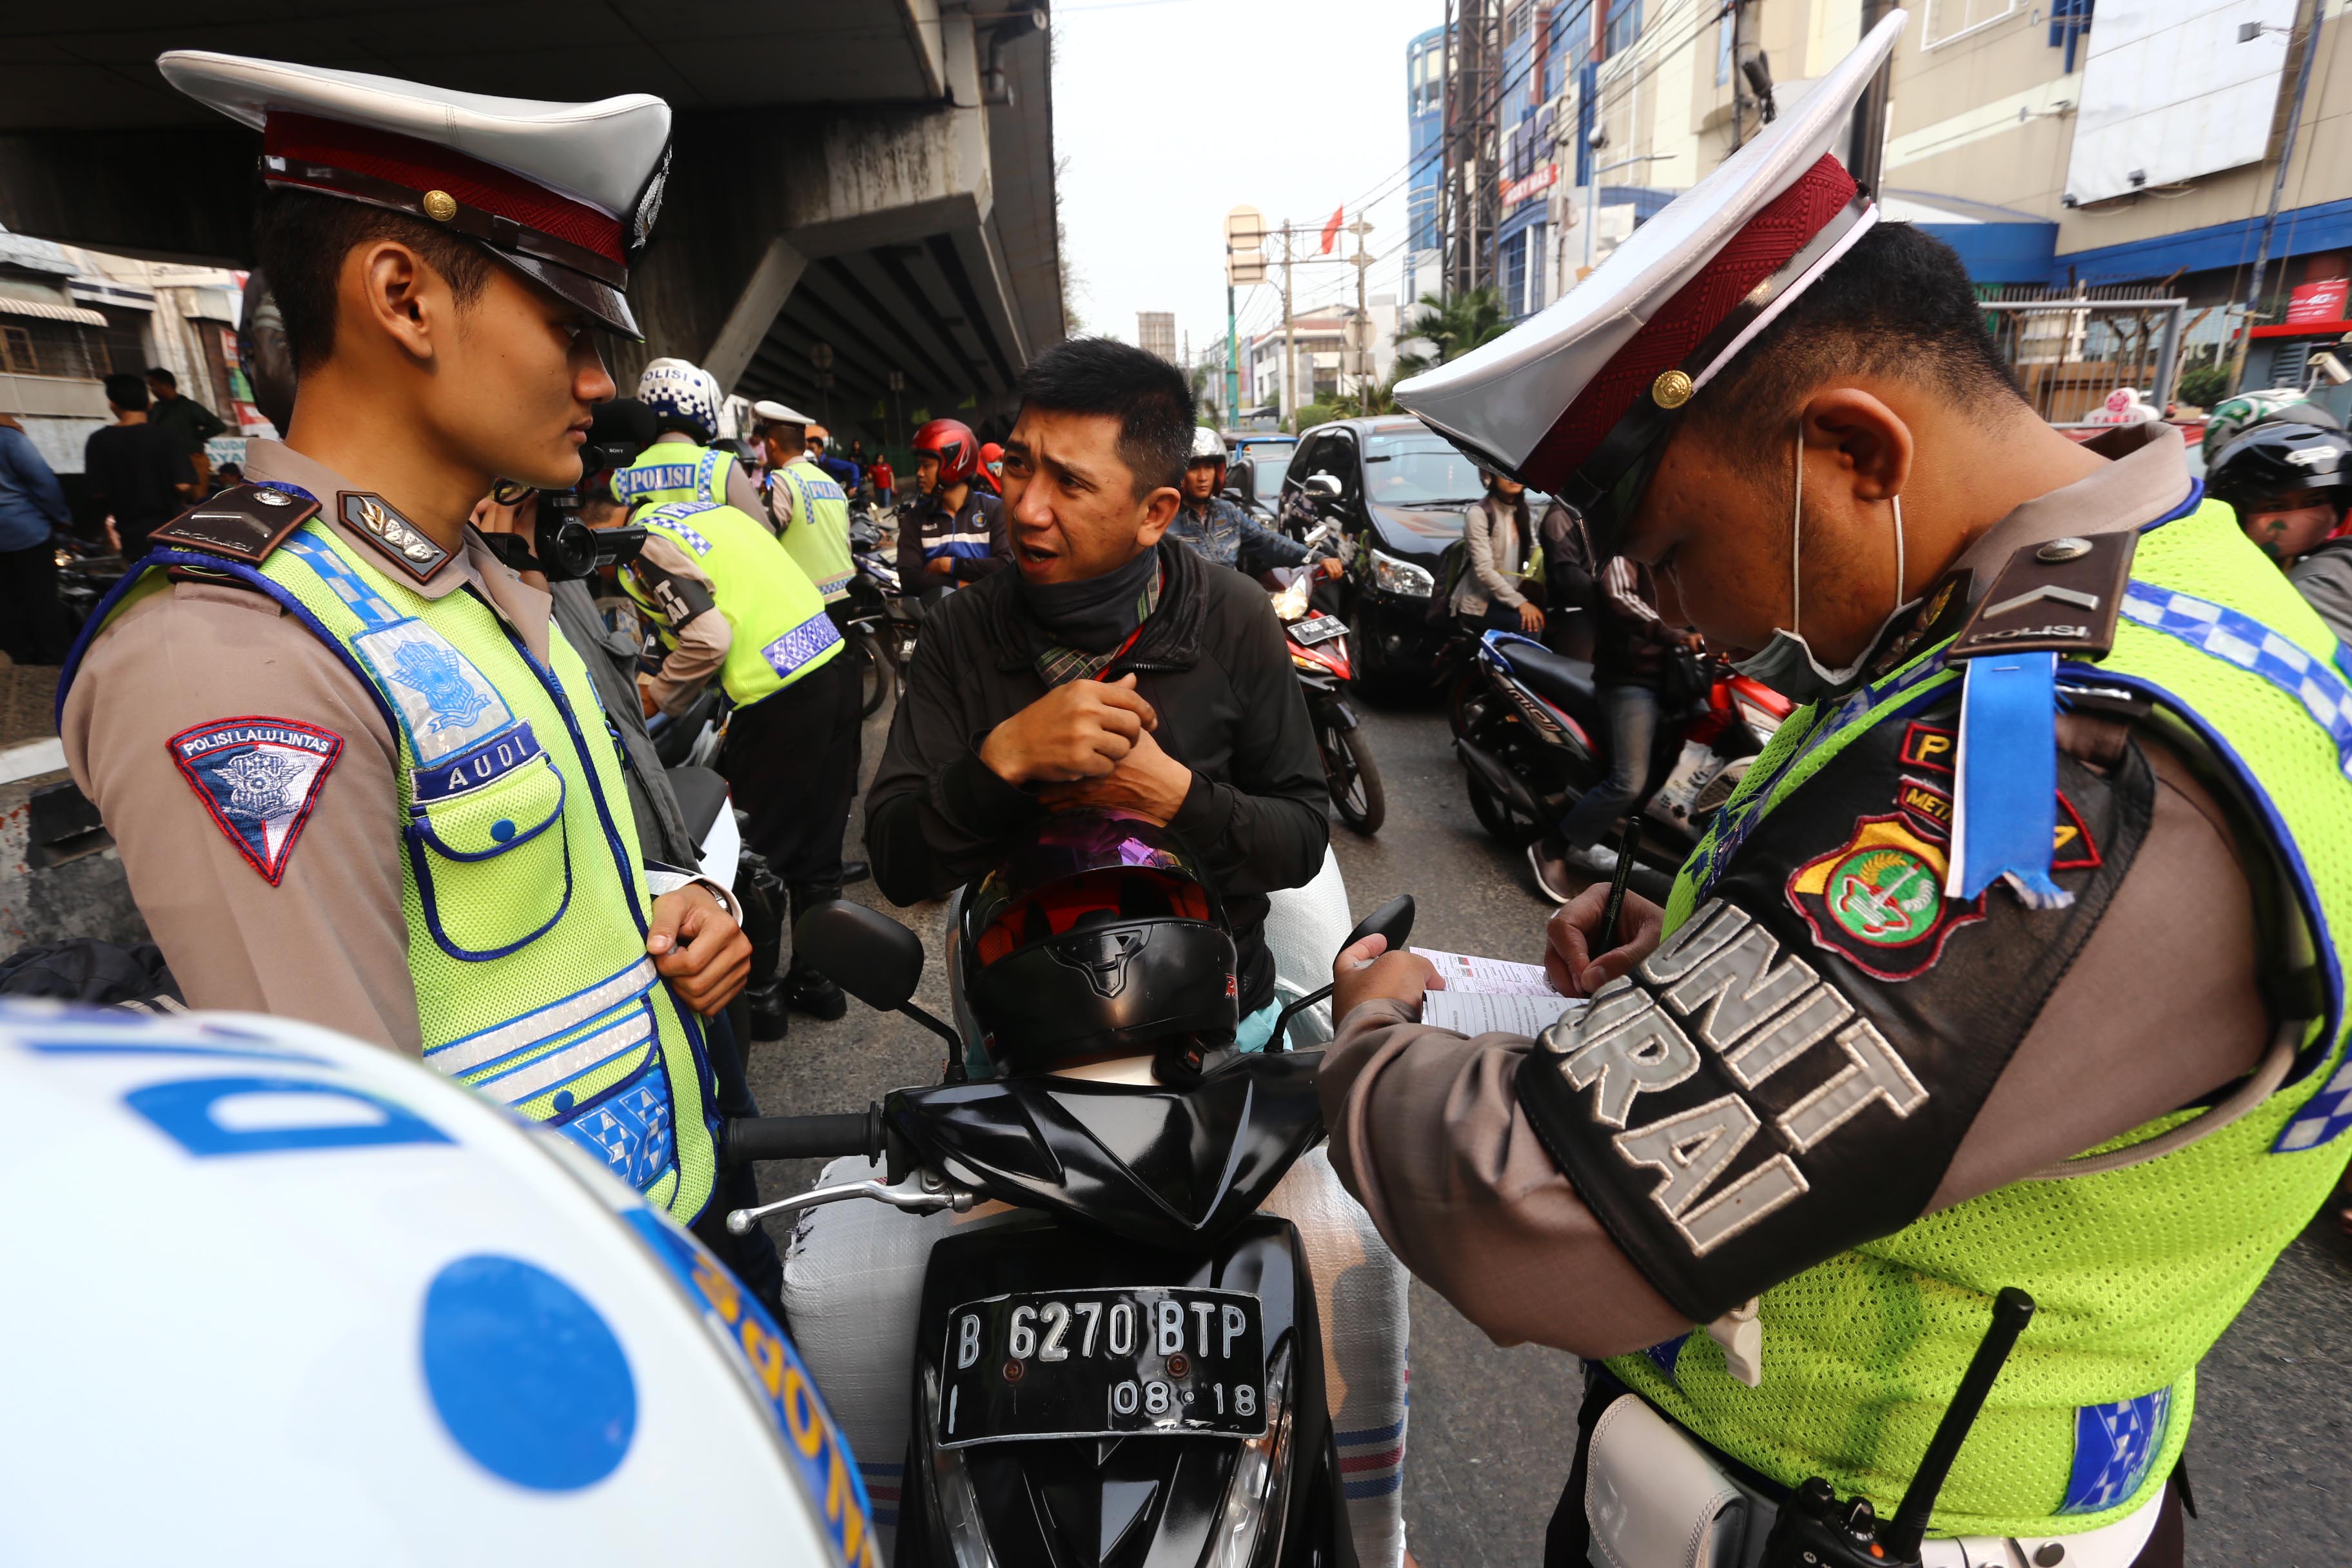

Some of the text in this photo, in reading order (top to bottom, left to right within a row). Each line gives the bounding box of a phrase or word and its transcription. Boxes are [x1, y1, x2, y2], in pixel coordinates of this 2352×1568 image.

[629, 466, 692, 491] POLISI
[1968, 625, 2088, 643] POLISI
[183, 729, 329, 756] POLISI LALU LINTAS
[449, 736, 527, 790] AUDI
[1639, 897, 1929, 1154] UNIT
[957, 1300, 1246, 1369] B 6270 BTP
